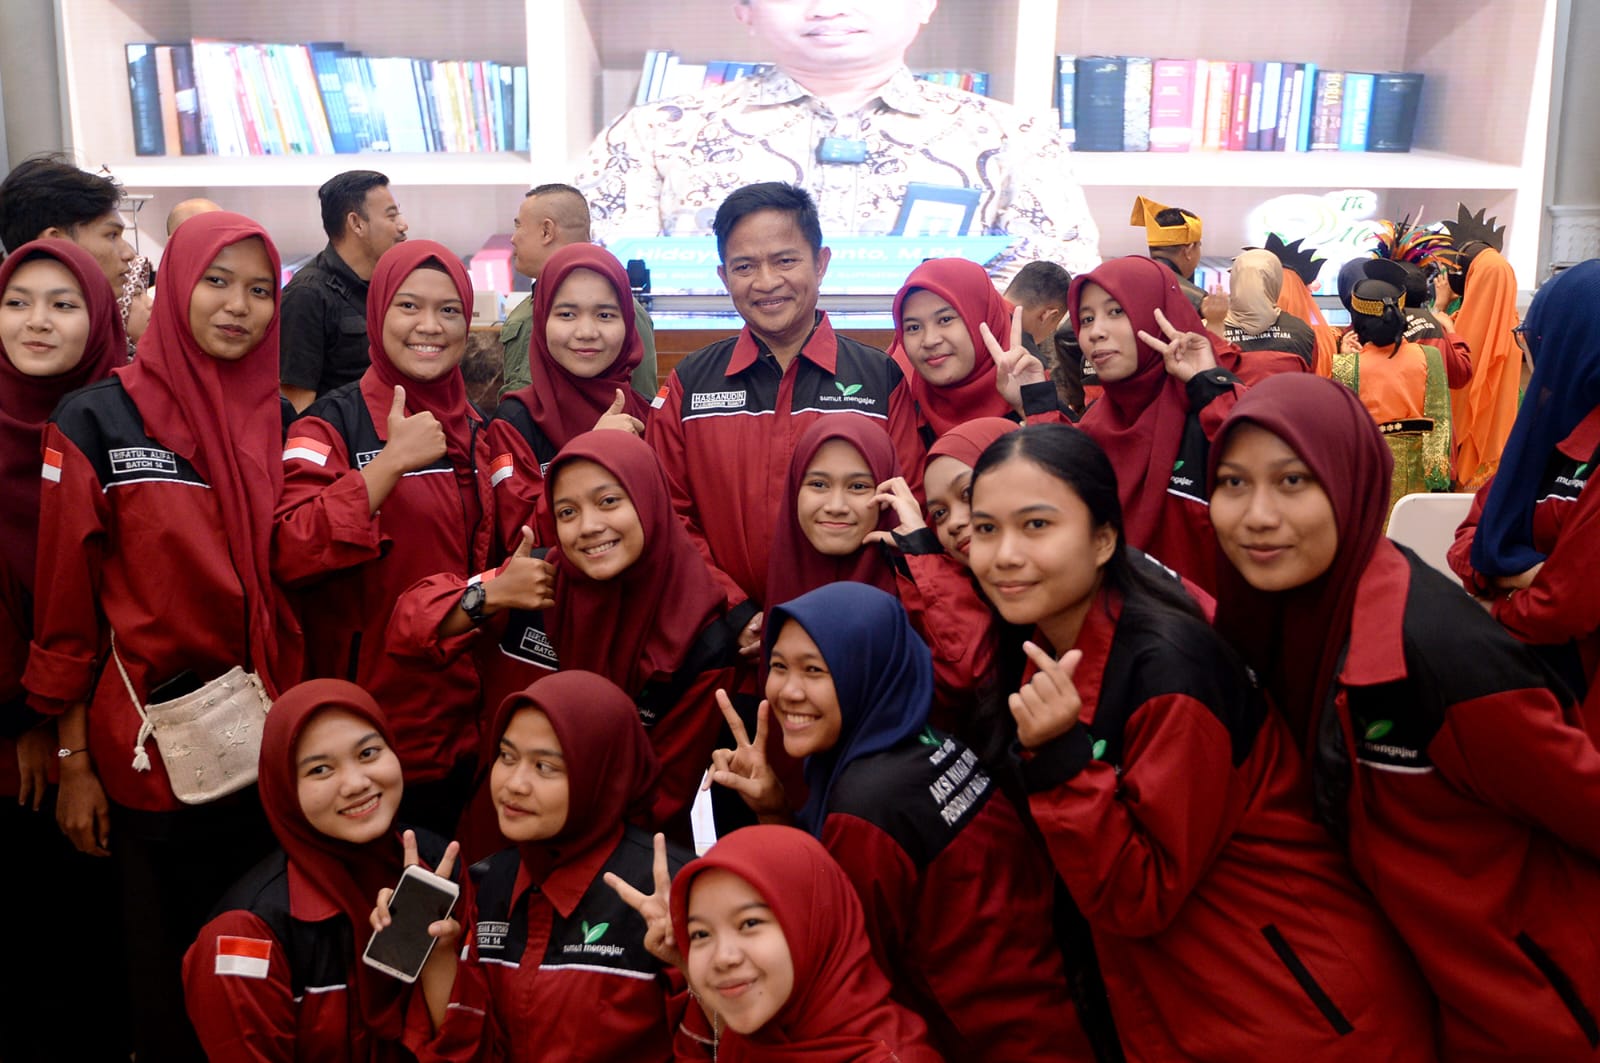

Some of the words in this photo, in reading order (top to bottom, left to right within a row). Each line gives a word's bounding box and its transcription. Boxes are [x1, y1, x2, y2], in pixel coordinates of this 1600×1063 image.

[694, 391, 744, 402] HASSANUDIN
[843, 396, 876, 405] mengajar
[150, 450, 172, 460] ALIFA
[125, 460, 153, 469] BATCH
[154, 461, 163, 469] 14
[928, 773, 956, 805] AKSI
[493, 935, 501, 945] 14
[583, 943, 625, 957] mengajar
